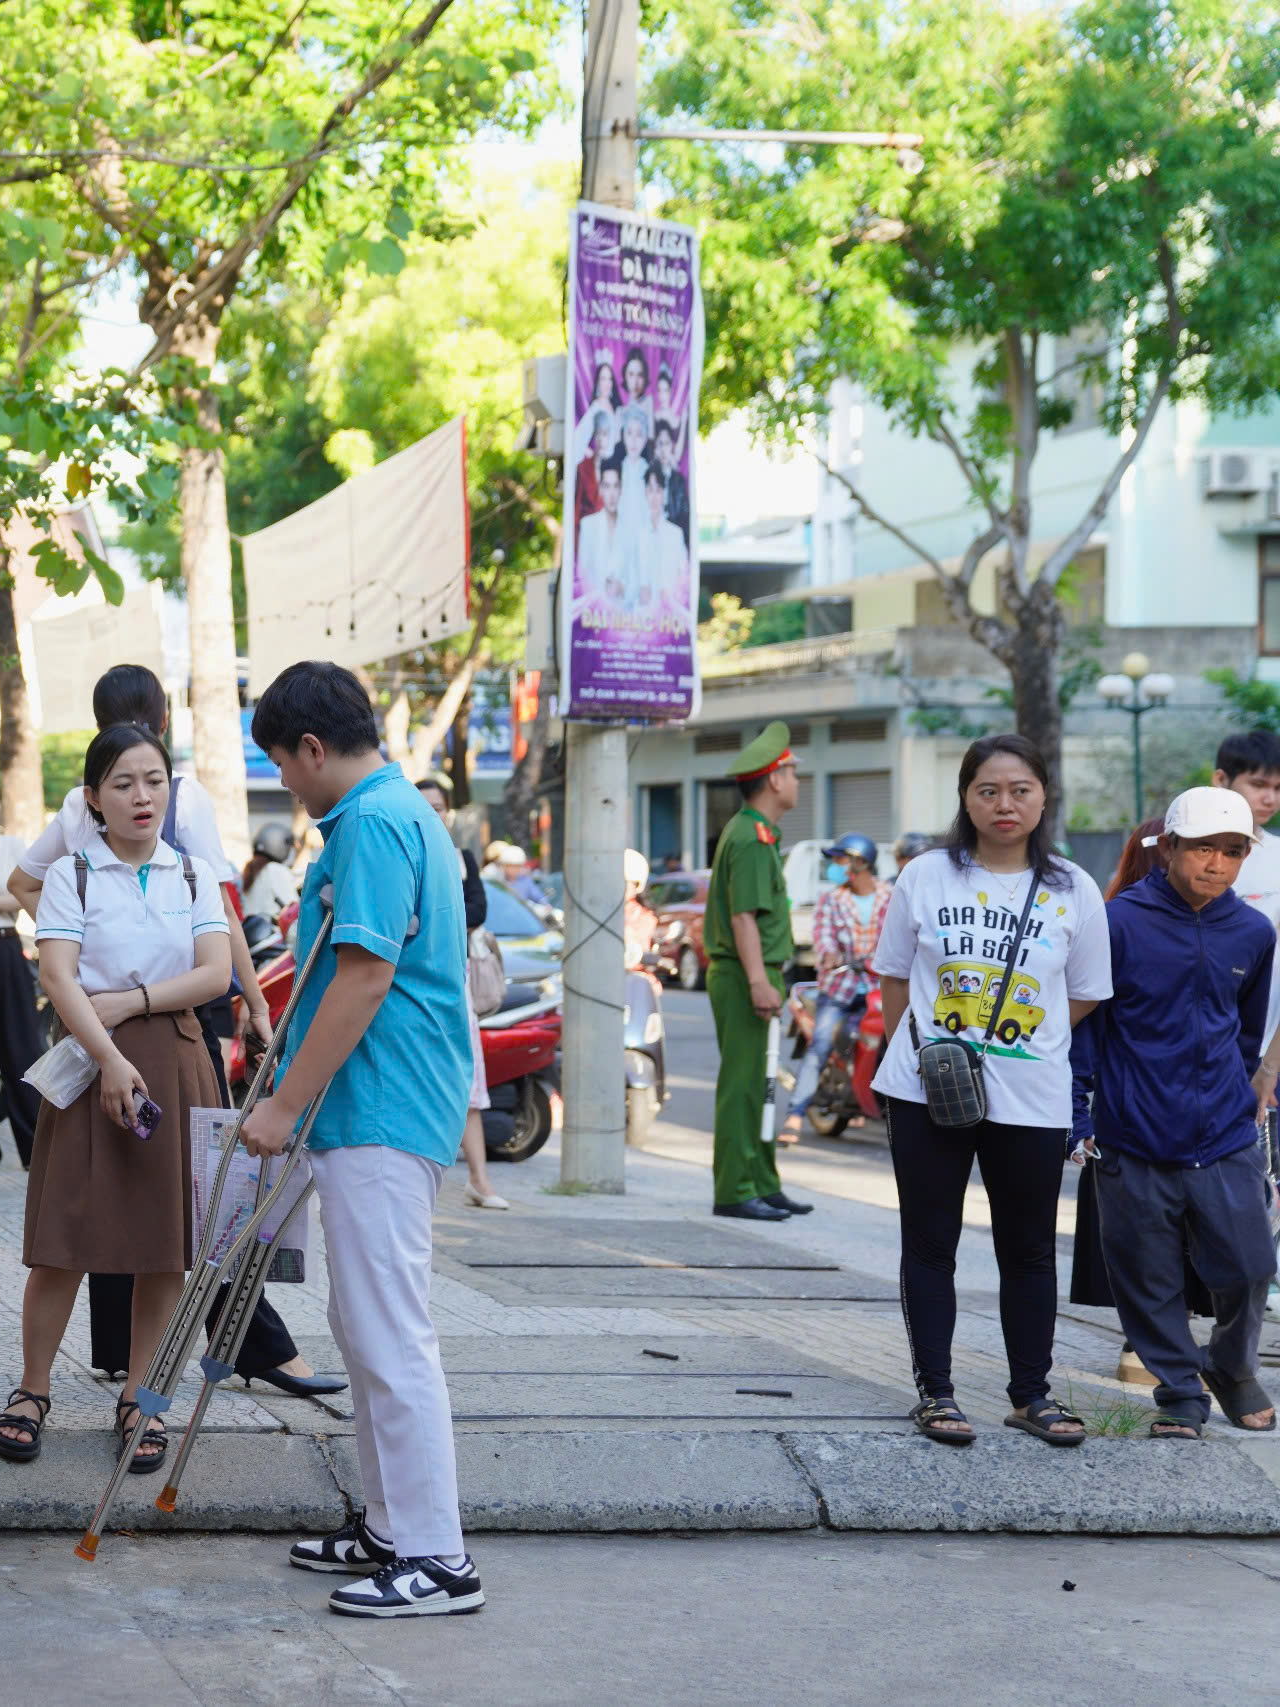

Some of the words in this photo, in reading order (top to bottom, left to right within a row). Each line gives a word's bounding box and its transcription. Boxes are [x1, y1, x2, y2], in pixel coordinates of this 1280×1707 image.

[938, 906, 975, 927] GIA
[983, 906, 1044, 938] ĐÌNH
[943, 930, 974, 956] LÀ
[1019, 949, 1029, 967] 1
[982, 1000, 995, 1010] Bu
